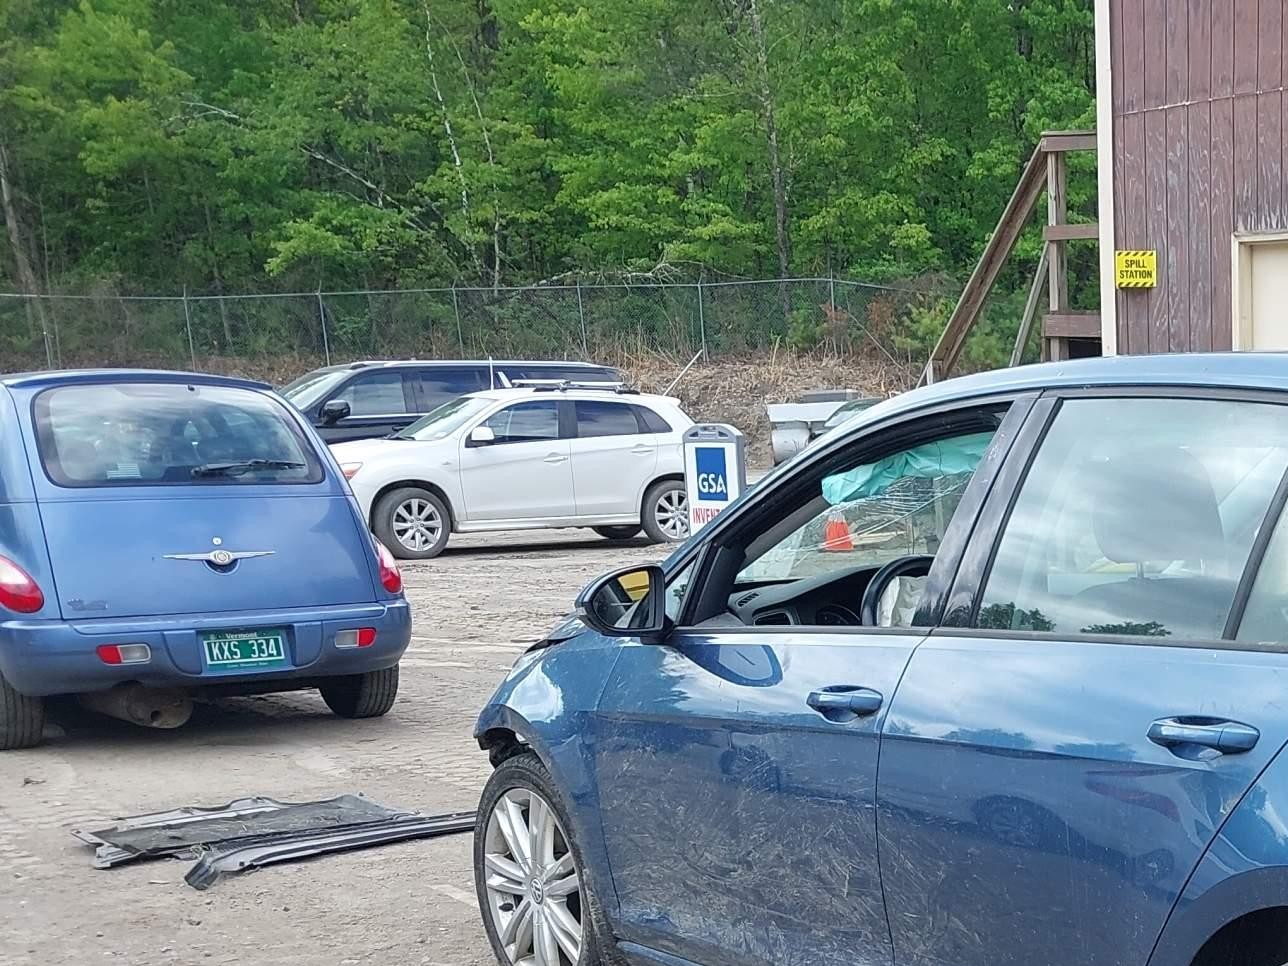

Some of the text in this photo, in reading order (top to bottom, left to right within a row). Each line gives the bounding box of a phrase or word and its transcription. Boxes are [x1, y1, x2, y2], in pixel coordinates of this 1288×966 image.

[1125, 259, 1147, 269] SPILL
[1119, 270, 1153, 279] STATION
[699, 473, 727, 495] GSA
[211, 638, 277, 661] KXS 334
